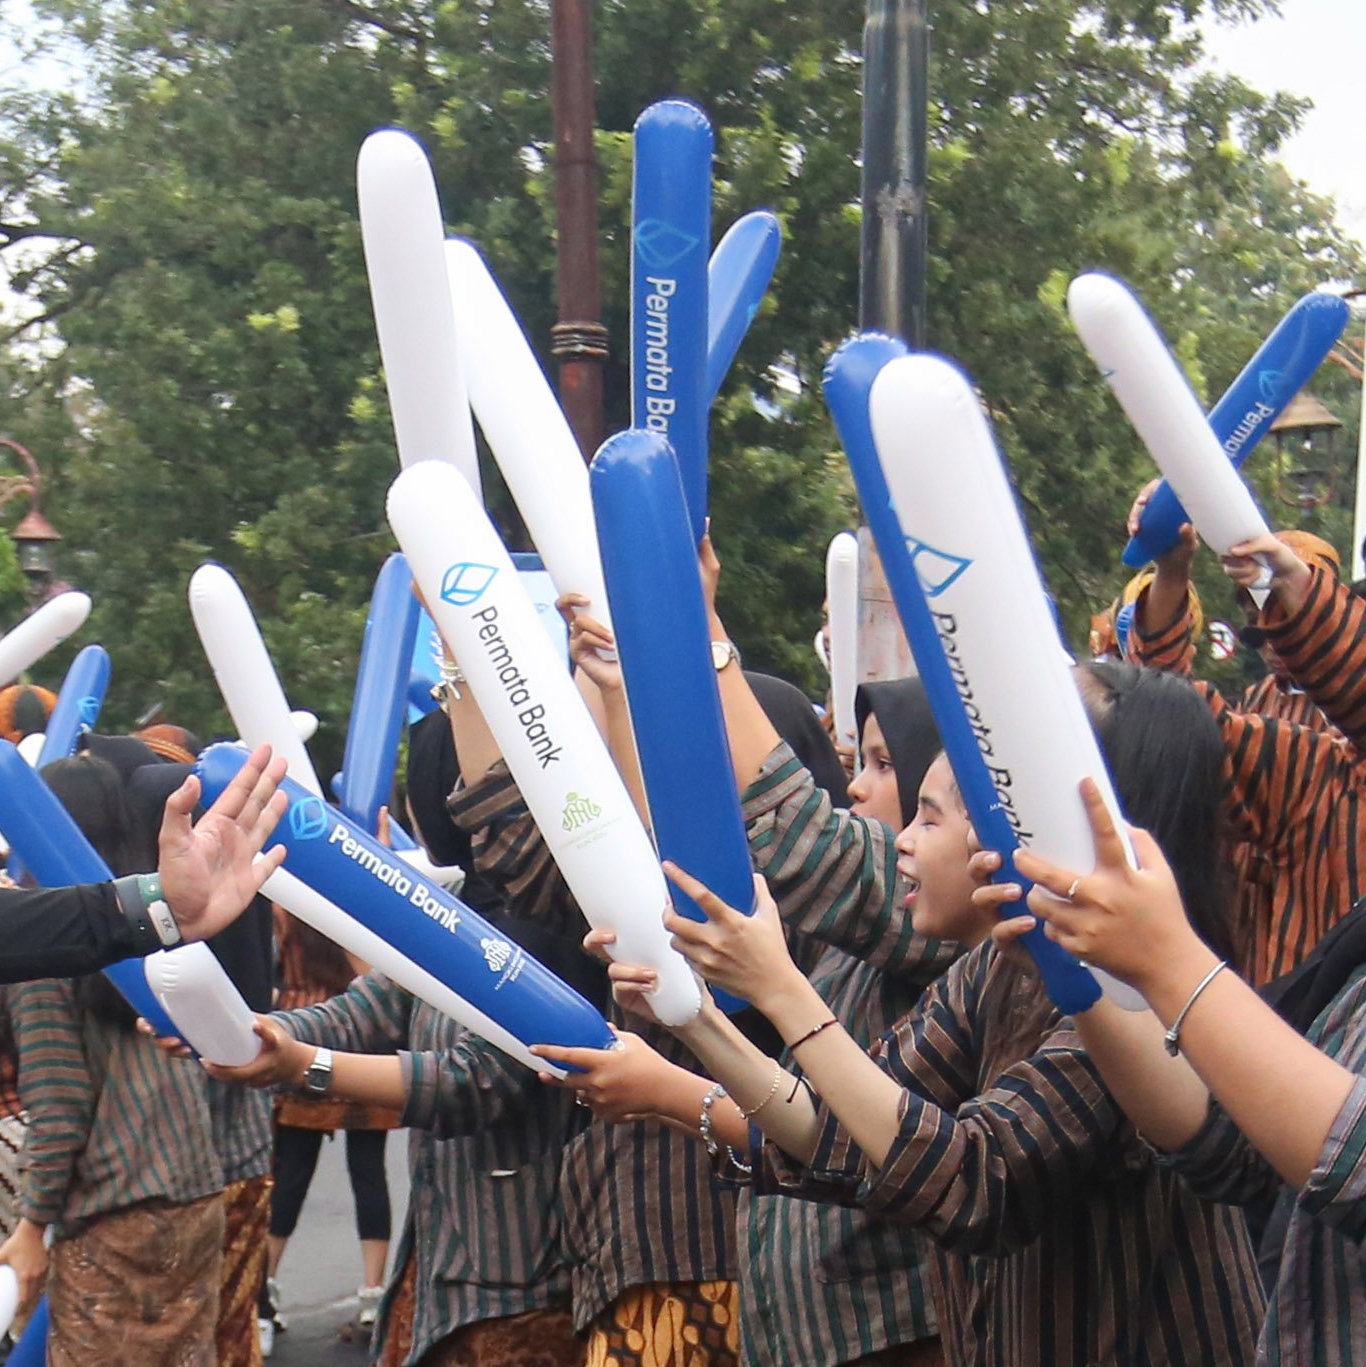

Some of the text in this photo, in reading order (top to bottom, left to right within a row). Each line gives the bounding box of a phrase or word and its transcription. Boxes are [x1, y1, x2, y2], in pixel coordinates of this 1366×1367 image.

[646, 276, 676, 439] Permata Ba
[471, 605, 563, 770] Permata Bank
[328, 823, 462, 934] Permata Bank
